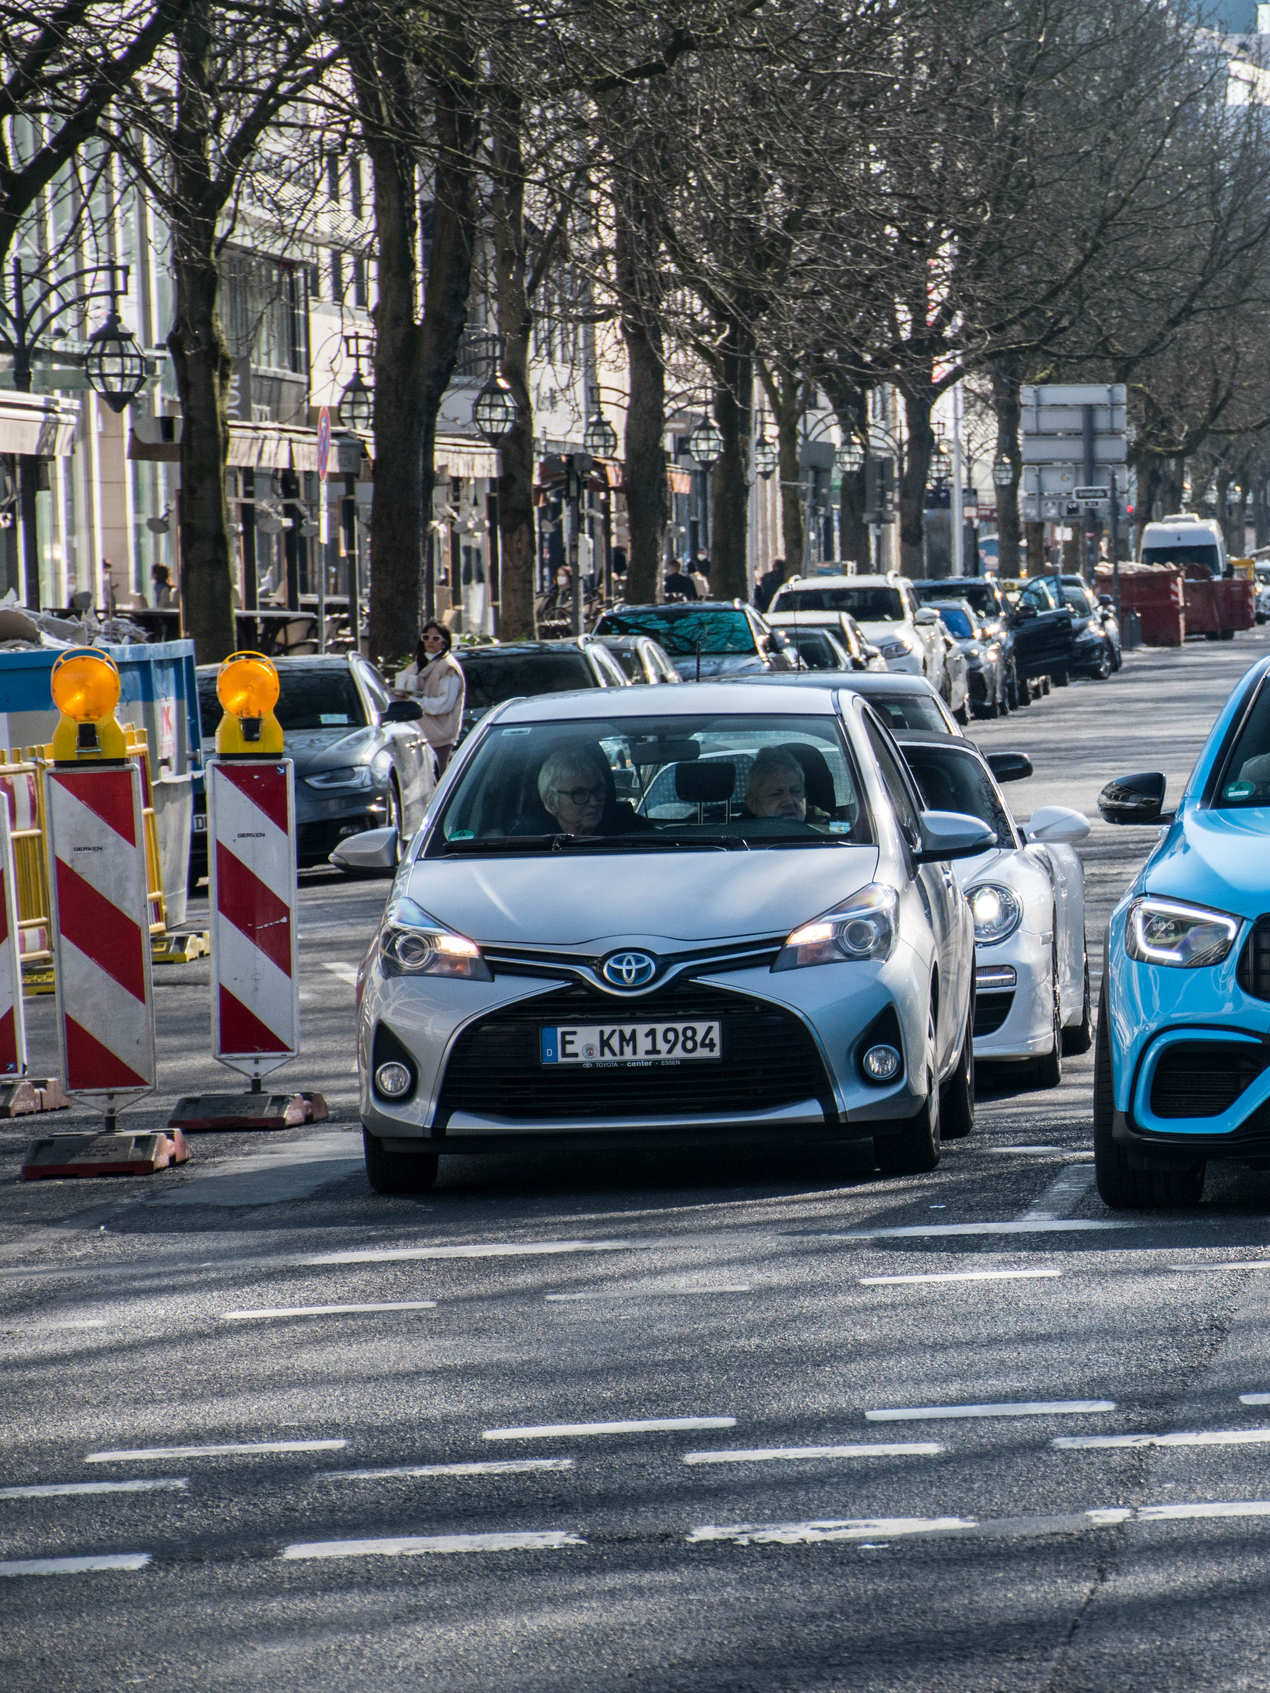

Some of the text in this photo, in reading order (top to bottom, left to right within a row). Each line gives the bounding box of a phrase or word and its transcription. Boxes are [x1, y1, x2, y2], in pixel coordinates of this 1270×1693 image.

[560, 1025, 717, 1058] E KM 1984
[546, 1048, 553, 1057] D
